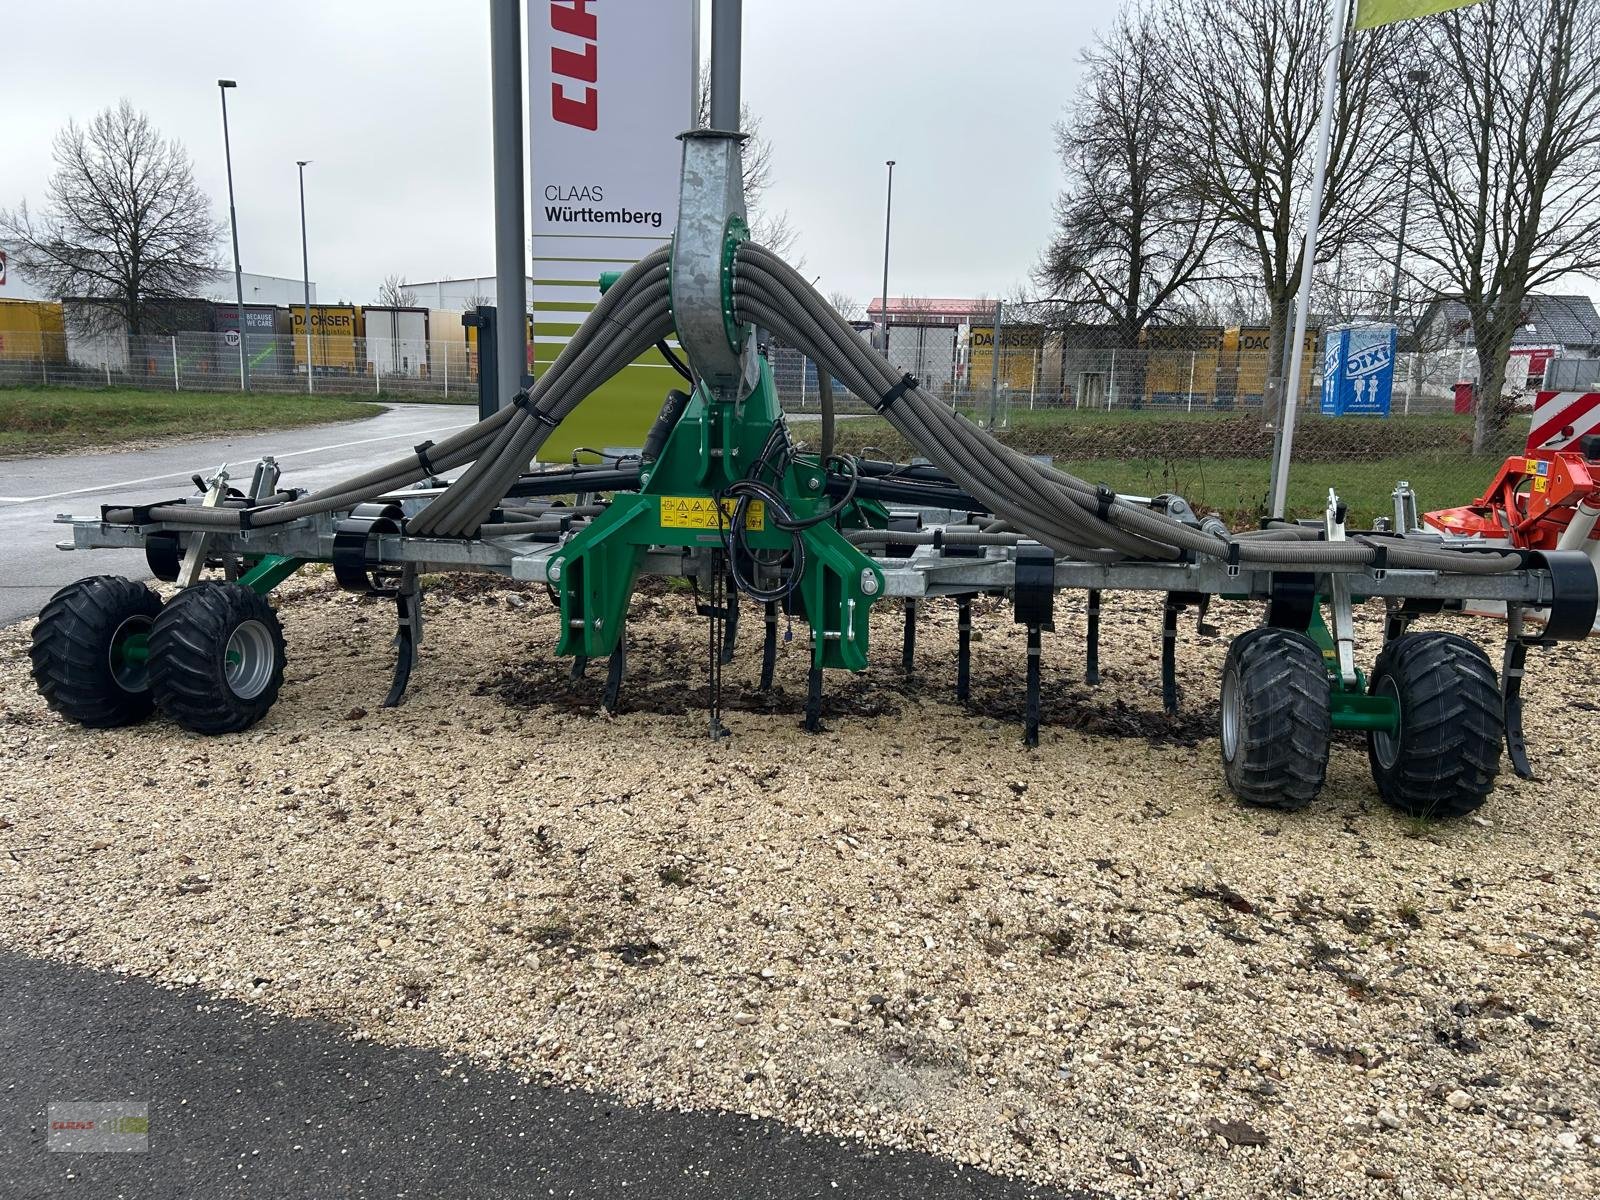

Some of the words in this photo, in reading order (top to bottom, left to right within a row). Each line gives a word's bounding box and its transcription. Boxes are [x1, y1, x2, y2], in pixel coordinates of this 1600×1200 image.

[544, 185, 603, 202] CLAAS
[544, 206, 662, 227] Württemberg
[246, 313, 273, 321] BECAUSE
[1245, 336, 1311, 350] DACR
